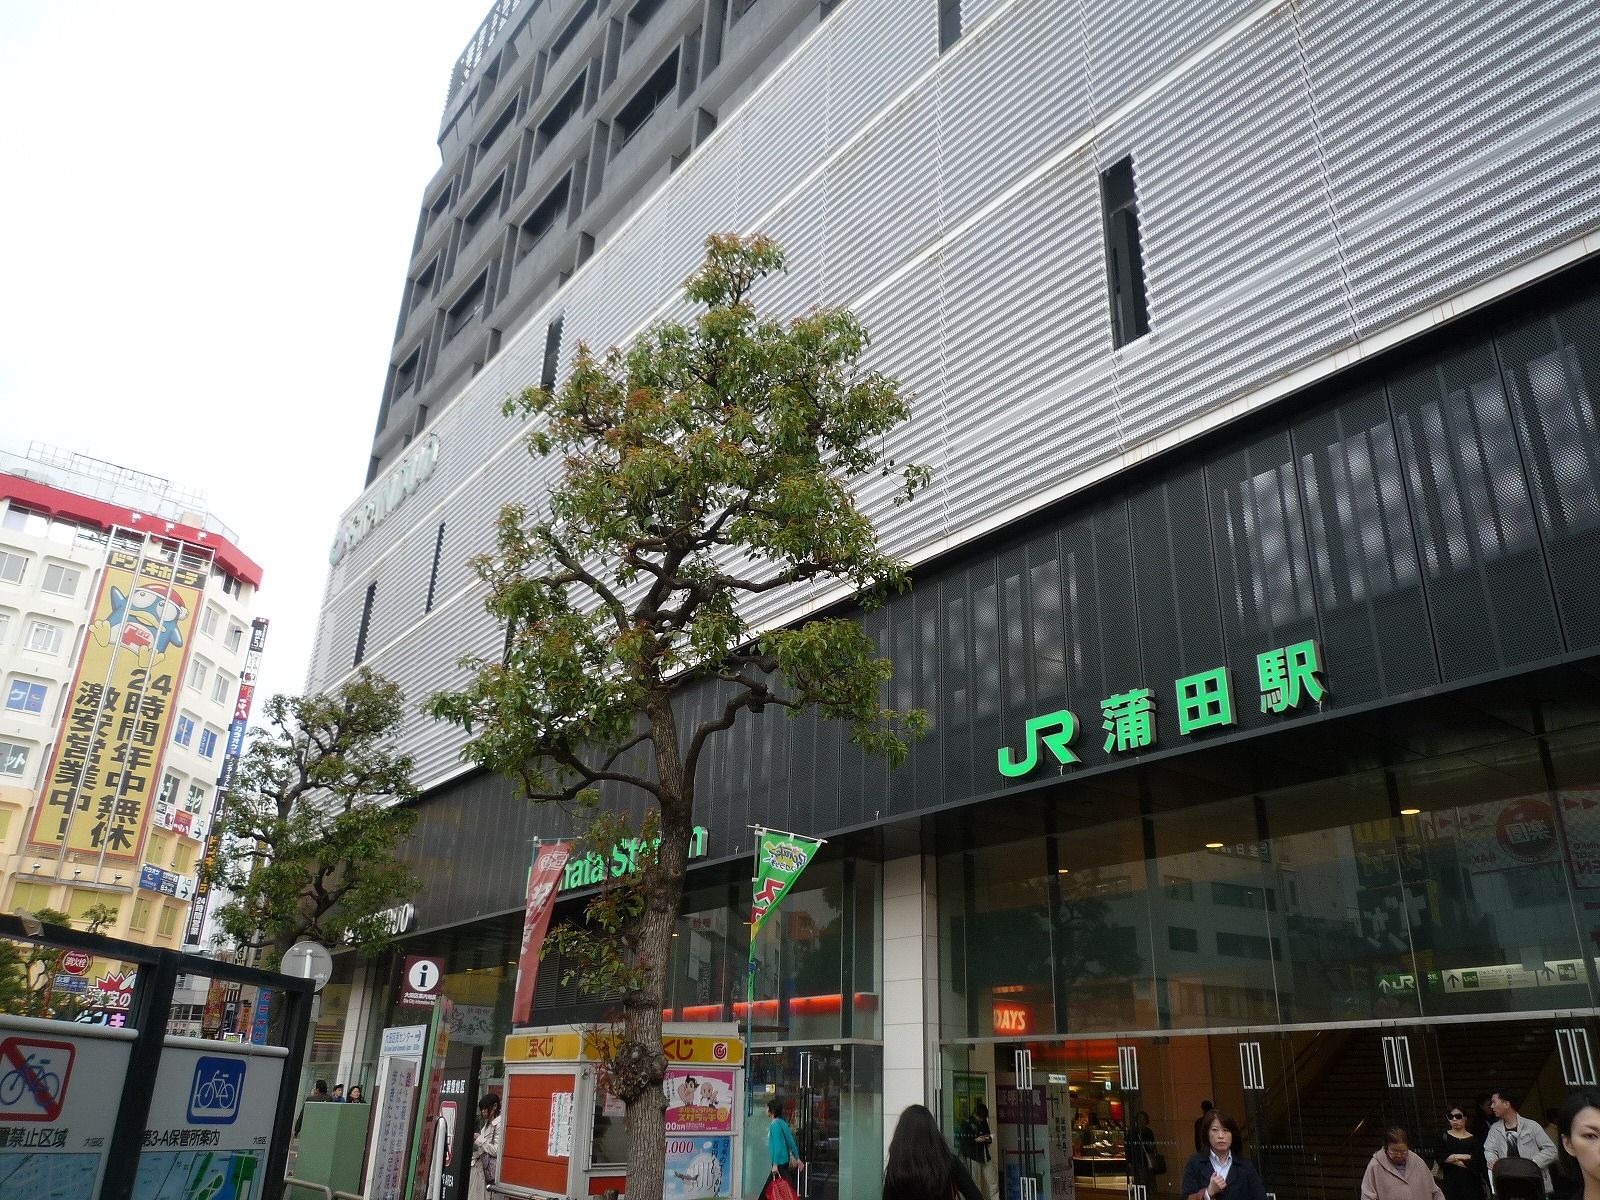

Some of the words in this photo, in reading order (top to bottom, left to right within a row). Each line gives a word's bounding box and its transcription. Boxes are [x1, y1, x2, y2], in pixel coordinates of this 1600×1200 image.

[997, 709, 1082, 778] JR
[1100, 639, 1328, 755] 蒲田駅
[90, 668, 172, 850] 24時間年中無休
[65, 957, 87, 968] 消火栓
[993, 1008, 1026, 1031] DAYS
[528, 1038, 554, 1058] 宝くじ
